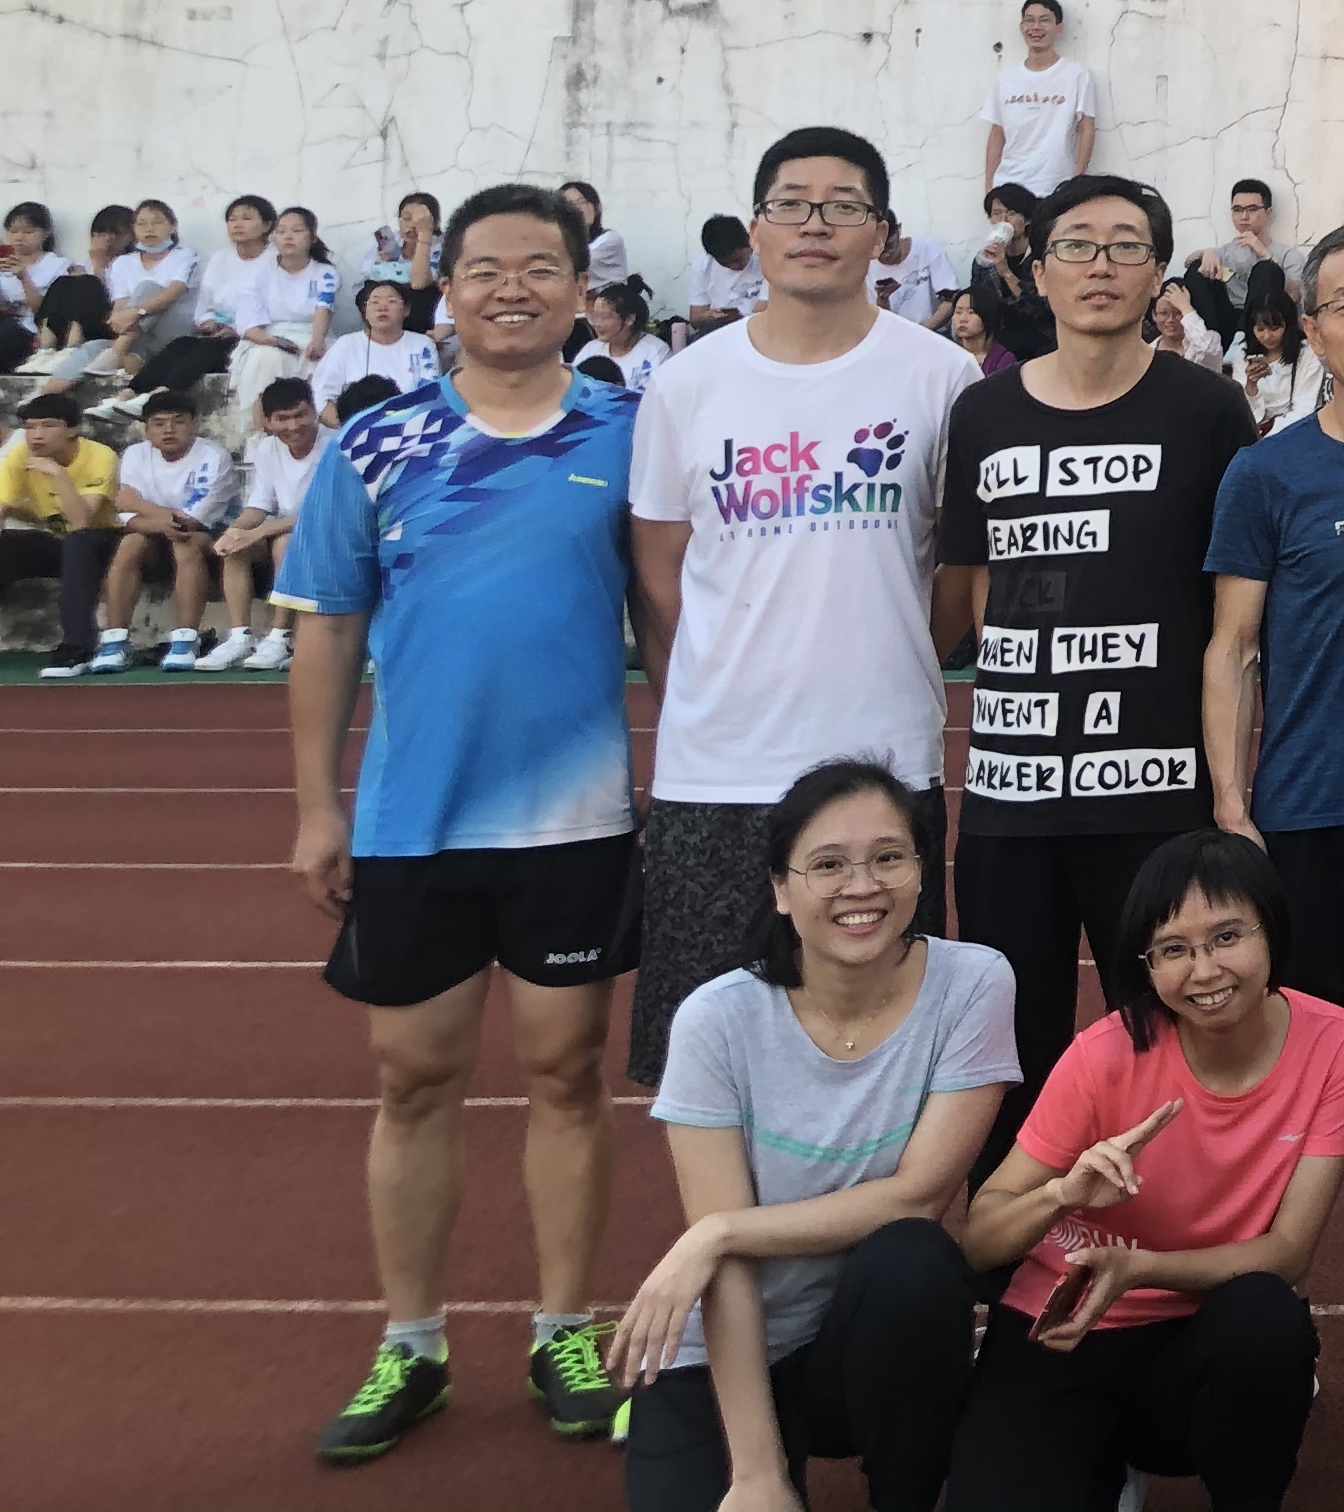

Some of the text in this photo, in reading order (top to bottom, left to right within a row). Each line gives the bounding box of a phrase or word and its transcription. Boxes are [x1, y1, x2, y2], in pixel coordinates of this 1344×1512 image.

[709, 431, 823, 482] Jack
[1058, 454, 1154, 487] STOP
[710, 471, 903, 526] Wolfskin
[1057, 631, 1146, 664] THEY
[1093, 697, 1113, 729] A
[1075, 757, 1188, 791] COLOR
